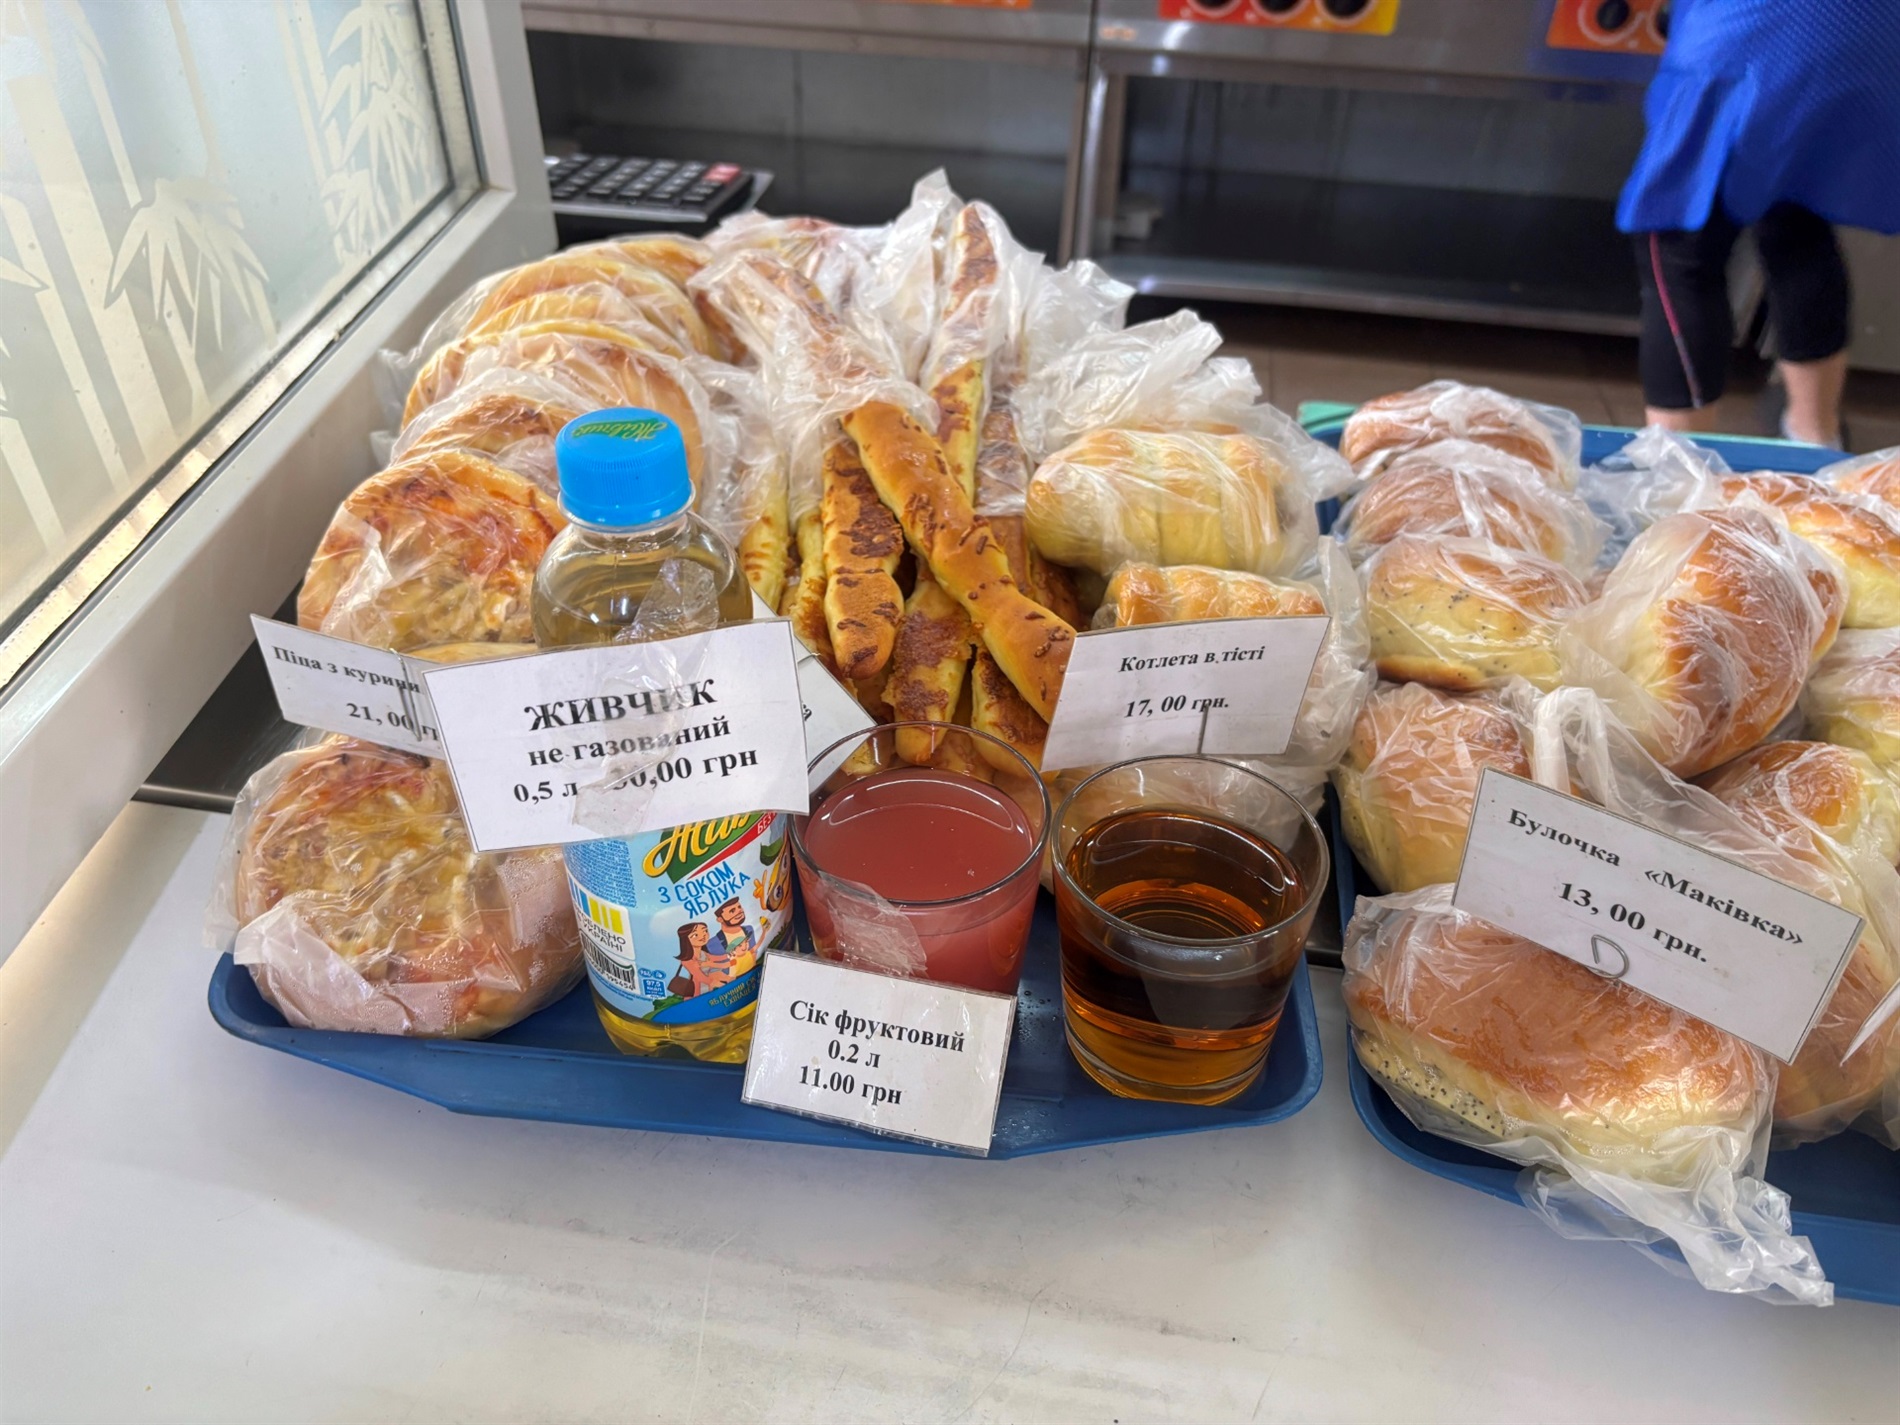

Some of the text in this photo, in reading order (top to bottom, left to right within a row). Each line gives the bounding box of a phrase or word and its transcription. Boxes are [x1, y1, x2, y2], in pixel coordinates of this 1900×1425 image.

[272, 646, 421, 694] Піца з курини
[1118, 646, 1266, 673] Котлета в тісті
[346, 703, 383, 726] 21,
[387, 711, 414, 731] 00
[523, 678, 718, 732] ЖИВЧИК
[1124, 695, 1229, 718] 17, 00 грн.
[528, 715, 731, 766] не газований
[513, 781, 553, 804] 0,5
[562, 782, 578, 797] л
[702, 749, 759, 777] грн
[674, 861, 735, 903] СОКОМ
[683, 871, 751, 919] ЯБЛУКА
[1507, 808, 1803, 945] Булочка «Маківка»
[1558, 882, 1708, 963] 13, 00 грн.
[790, 1000, 965, 1052] Сік фруктовий
[828, 1040, 880, 1068] 0.2 л
[799, 1065, 902, 1106] 11.00 грн
